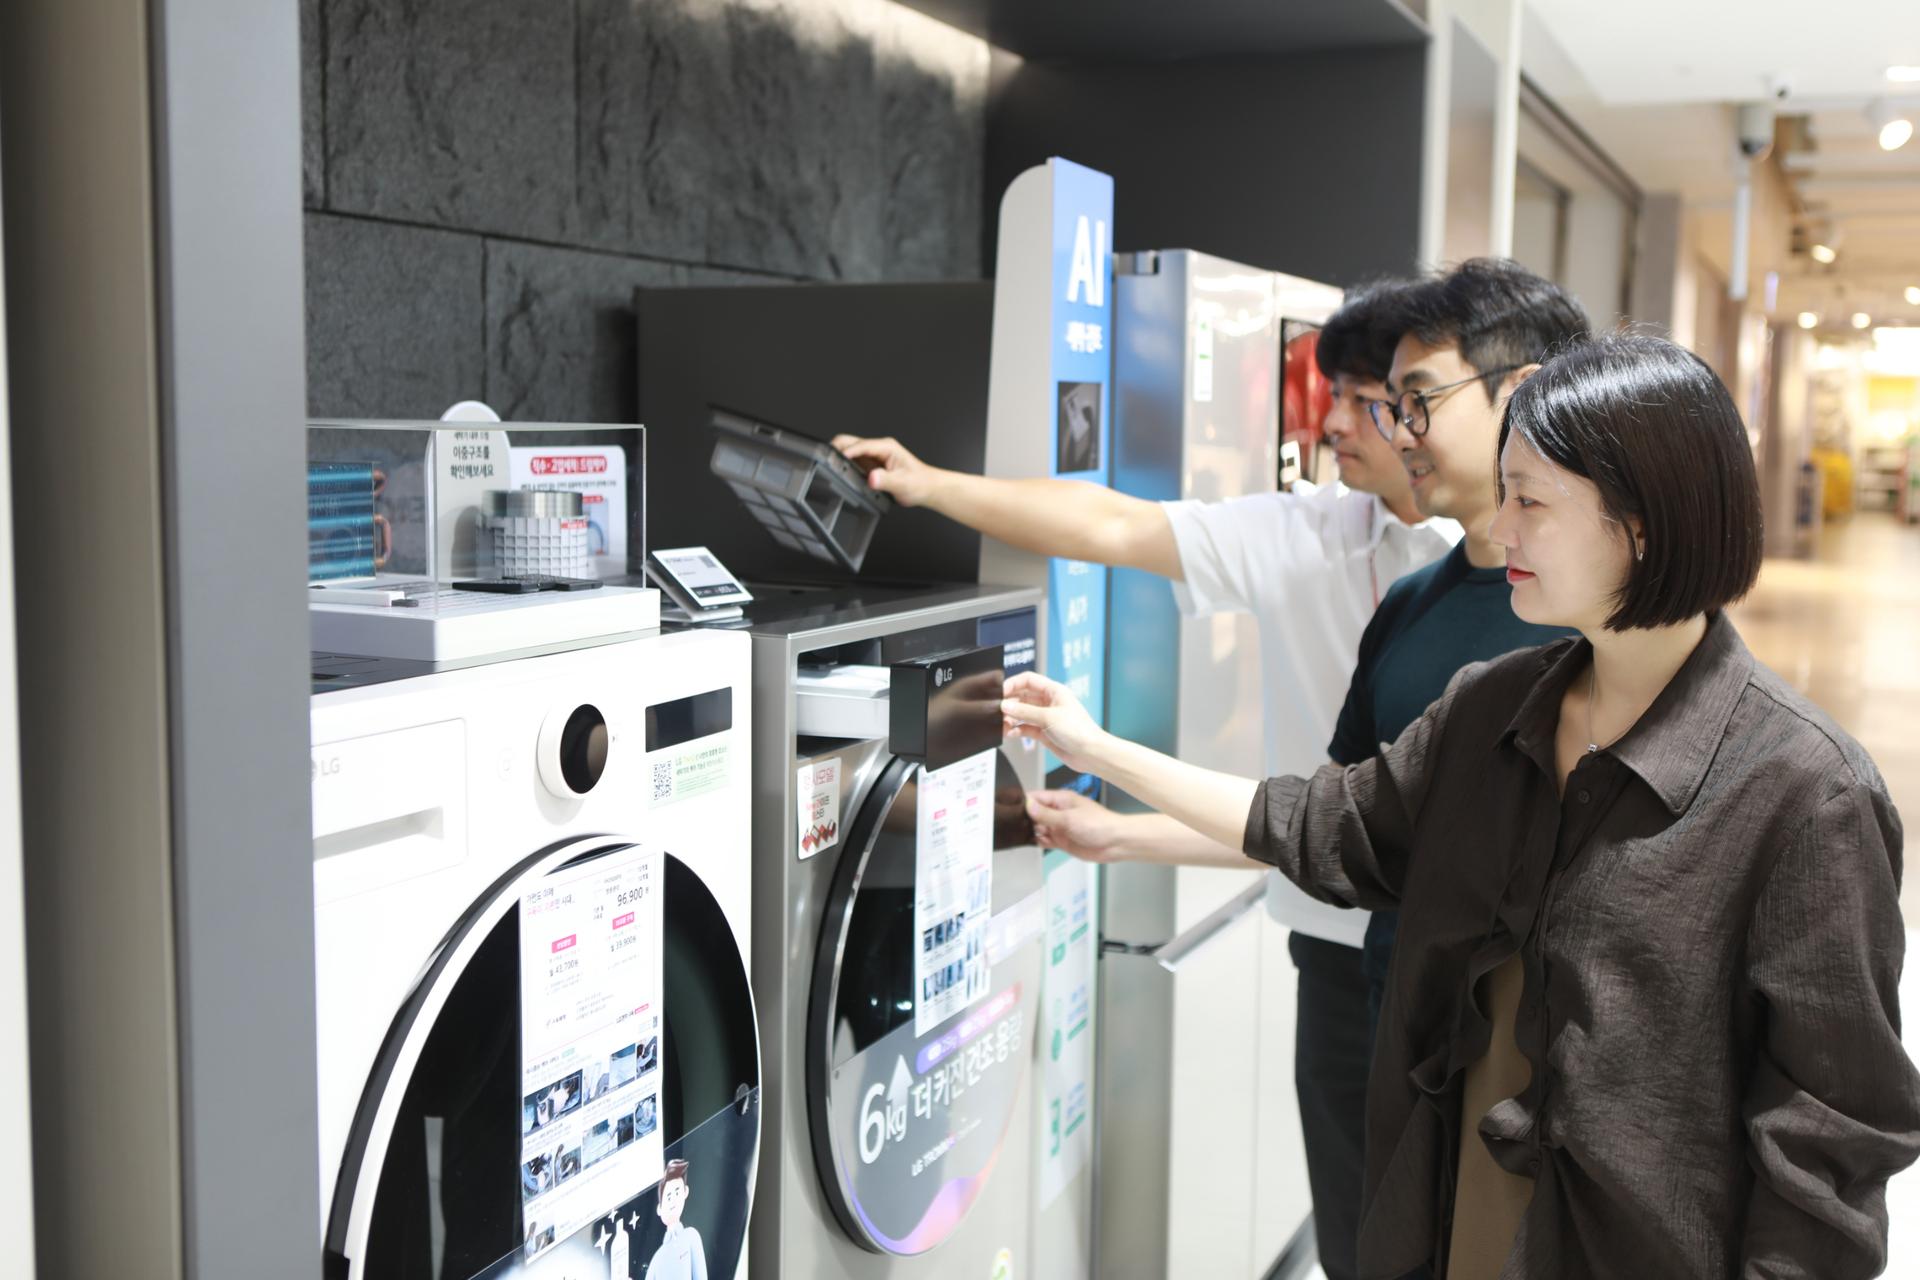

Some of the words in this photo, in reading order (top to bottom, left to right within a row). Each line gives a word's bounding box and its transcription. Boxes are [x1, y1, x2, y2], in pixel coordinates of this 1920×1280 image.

[1066, 214, 1105, 307] AI
[453, 445, 490, 461] 이중구조를
[450, 463, 495, 480] 확인해보세요
[943, 667, 953, 682] LG
[321, 756, 340, 777] LG
[859, 1082, 908, 1165] 6kg
[913, 1076, 931, 1120] 더
[933, 1054, 965, 1107] 커진
[966, 1031, 995, 1087] 건조
